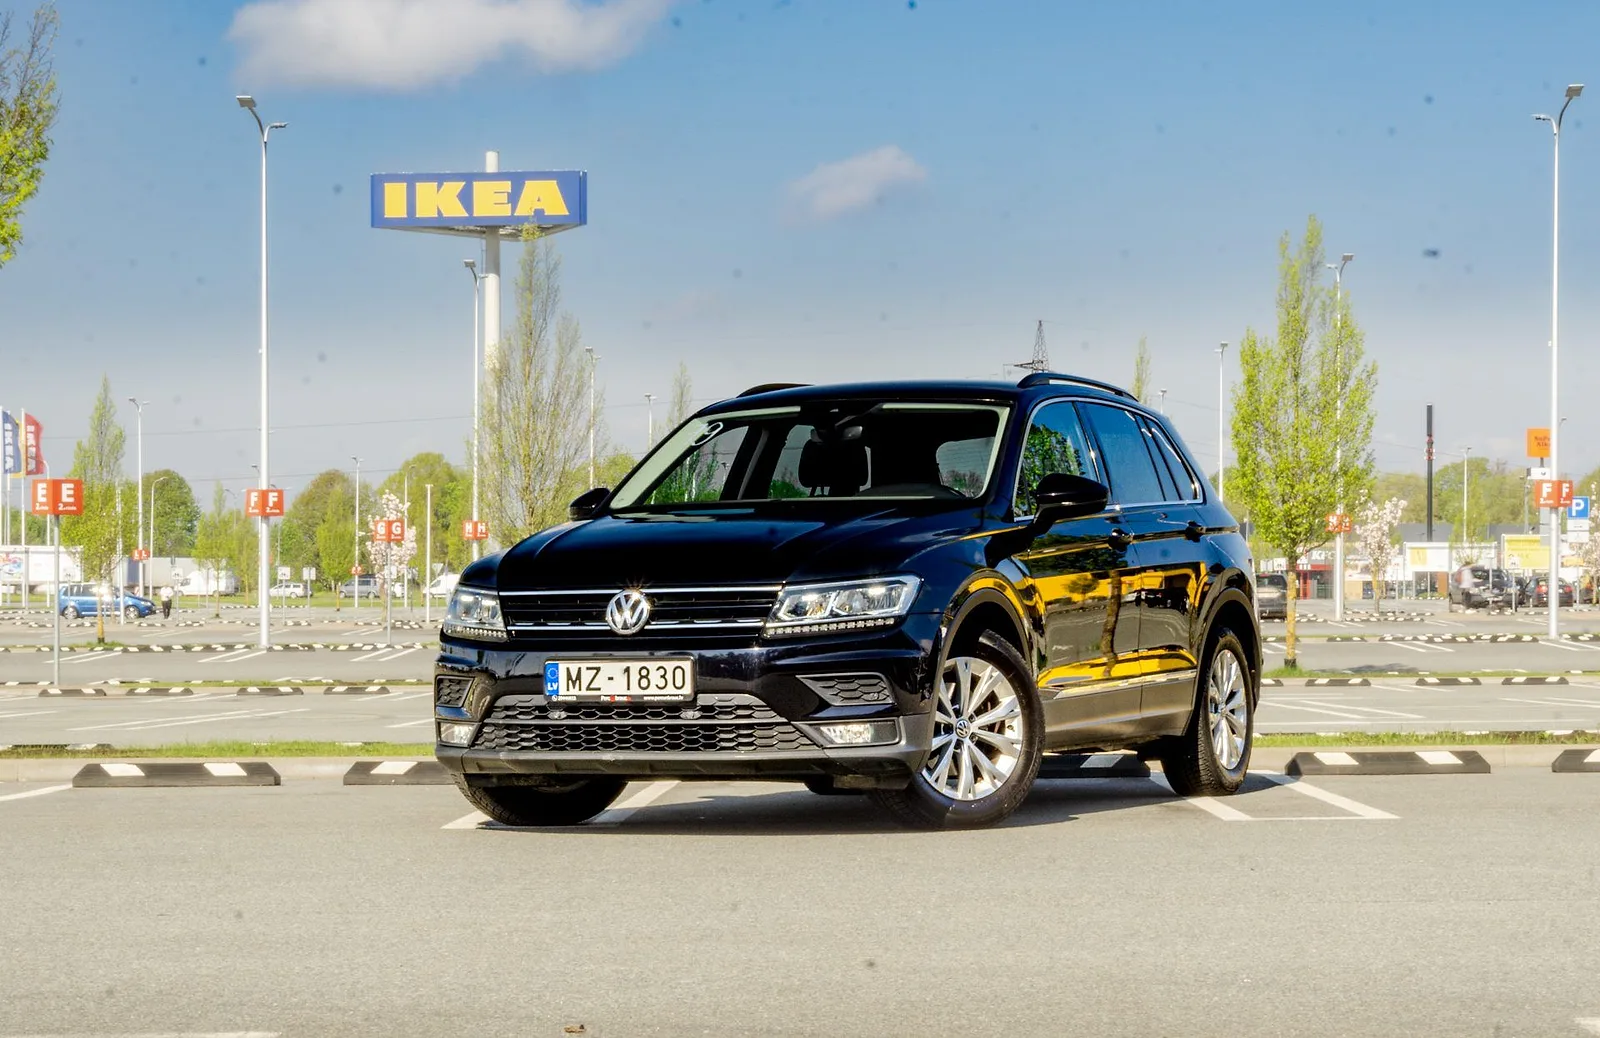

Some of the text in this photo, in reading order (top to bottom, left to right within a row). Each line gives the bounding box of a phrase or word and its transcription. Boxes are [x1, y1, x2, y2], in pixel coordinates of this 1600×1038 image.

[384, 180, 569, 218] IKEA
[37, 483, 48, 502] E
[61, 483, 75, 502] E
[1542, 483, 1553, 498] F
[1562, 483, 1570, 498] F
[250, 491, 258, 507] F
[268, 492, 278, 507] F
[1571, 499, 1585, 516] P
[391, 521, 402, 535] G
[607, 589, 650, 634] VW
[547, 682, 559, 690] LV
[566, 666, 686, 691] MZ-1830
